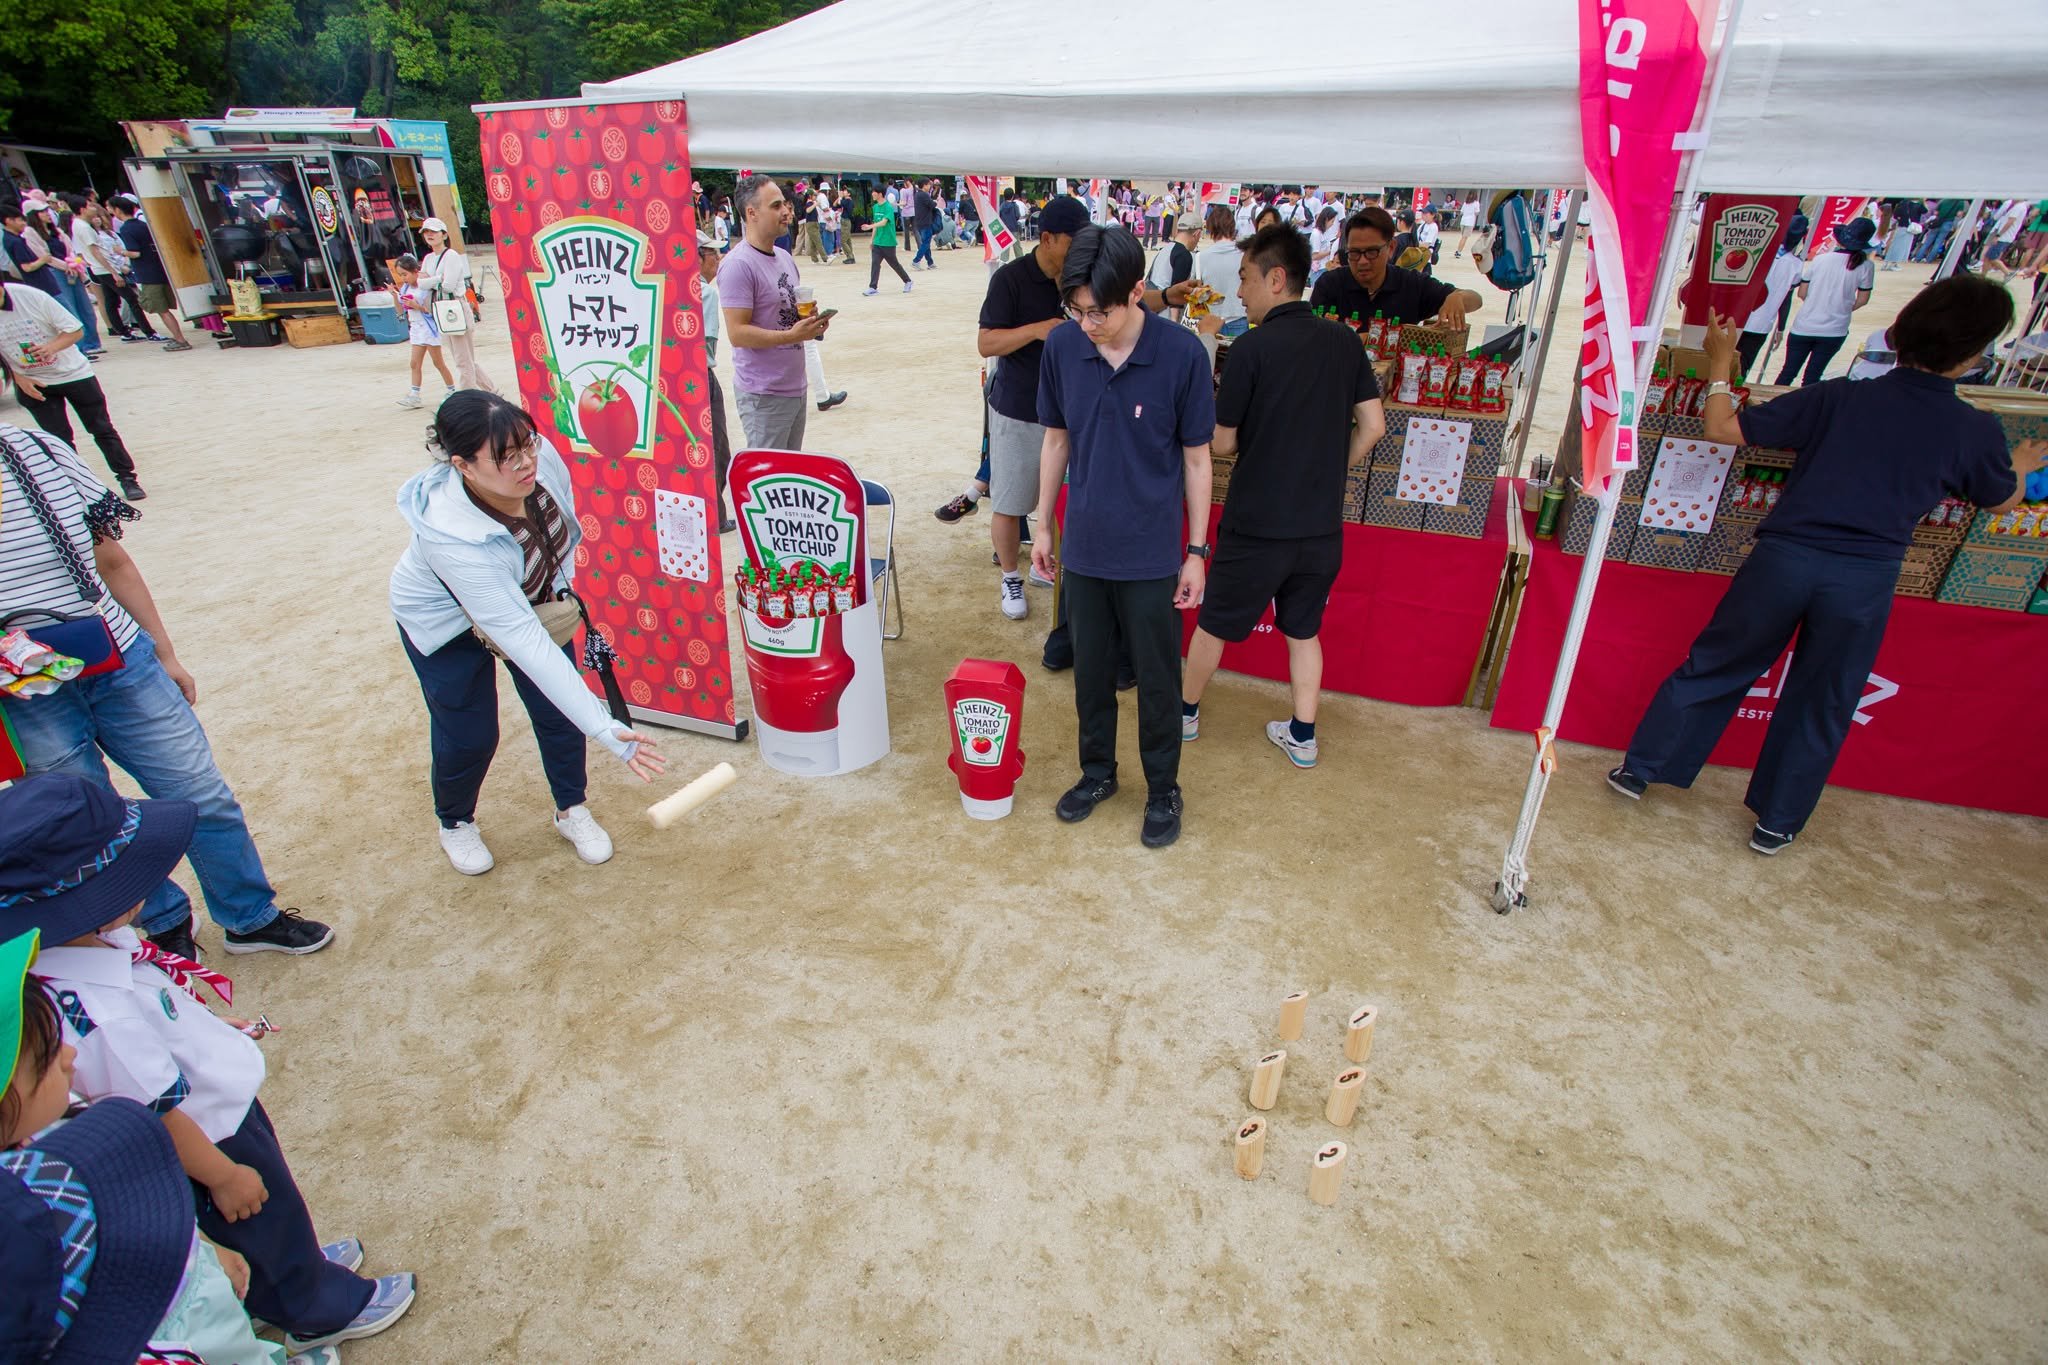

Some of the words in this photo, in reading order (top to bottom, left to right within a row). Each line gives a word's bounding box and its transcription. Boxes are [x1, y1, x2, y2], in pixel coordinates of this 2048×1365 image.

[1731, 211, 1769, 225] HEINZ
[1724, 228, 1766, 238] TOMATO
[1723, 237, 1760, 246] KETCHUP
[551, 237, 629, 276] HEINZ
[575, 273, 610, 284] ハインツ
[568, 294, 627, 322] トマト
[561, 323, 639, 348] ケチャップ
[764, 488, 829, 515] HEINZ
[764, 518, 839, 542] TOMATO
[772, 537, 836, 557] KETCHUP
[1252, 624, 1273, 634] 69
[768, 637, 785, 646] 460g
[964, 704, 997, 717] HEINZ
[963, 717, 1000, 728] TOMATO
[965, 725, 998, 735] KETCHUP
[1353, 1011, 1369, 1024] 1
[1339, 1071, 1358, 1083] 5
[1240, 1123, 1258, 1138] 3
[1319, 1147, 1338, 1162] 2
